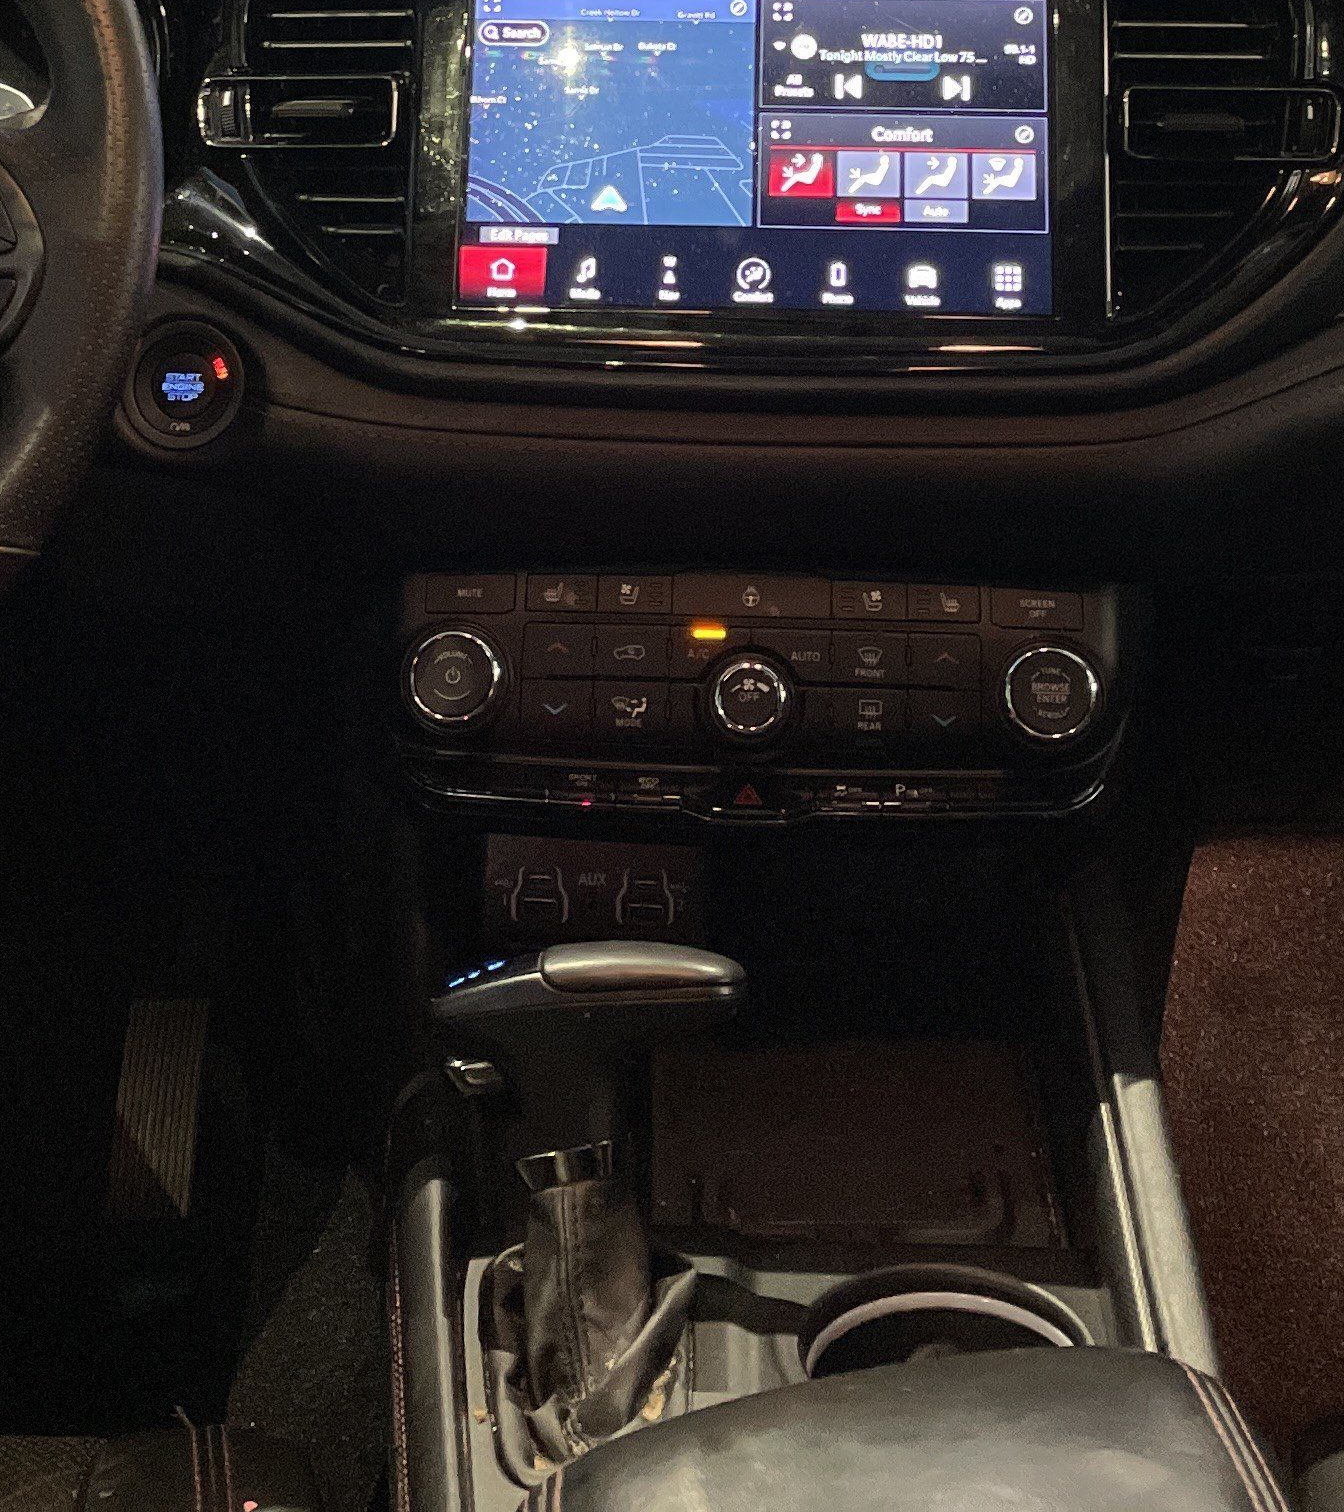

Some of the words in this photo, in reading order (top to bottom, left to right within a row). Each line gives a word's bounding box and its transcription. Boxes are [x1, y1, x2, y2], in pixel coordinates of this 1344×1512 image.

[502, 26, 542, 40] Search
[861, 33, 943, 49] WABE-HD1
[818, 49, 864, 64] Tonight
[864, 50, 902, 64] Mostly
[903, 50, 934, 63] Clear
[934, 51, 959, 63] Low
[871, 125, 934, 143] Comfort
[854, 203, 882, 217] Sync
[922, 205, 950, 218] Auto
[490, 229, 514, 241] Edit
[165, 373, 202, 382] START
[161, 382, 205, 392] ENGINE
[167, 392, 199, 401] STOP
[457, 588, 483, 598] MUTE
[1019, 598, 1056, 609] SCREEN
[1028, 609, 1047, 619] OFF
[687, 648, 709, 660] A/C
[790, 651, 821, 663] AUTO
[854, 667, 885, 678] FRONT
[1031, 682, 1070, 694] BROWSE
[739, 692, 760, 703] OFF
[1036, 694, 1067, 704] ENTER
[615, 717, 643, 728] MODE
[857, 720, 882, 731] REAR
[578, 872, 606, 886] AUX
